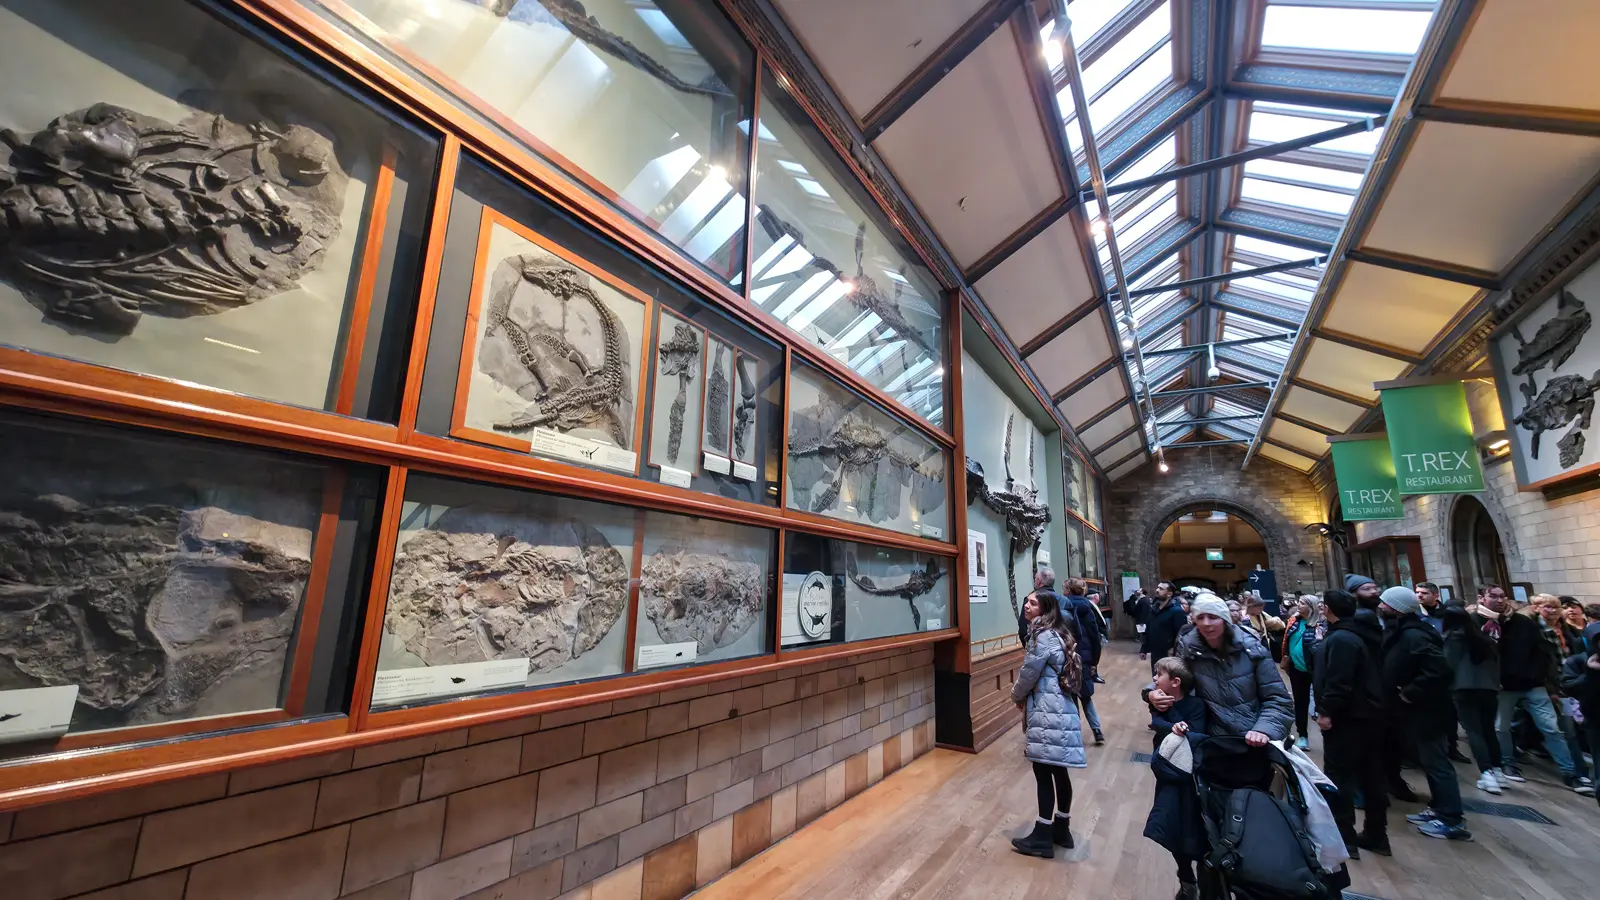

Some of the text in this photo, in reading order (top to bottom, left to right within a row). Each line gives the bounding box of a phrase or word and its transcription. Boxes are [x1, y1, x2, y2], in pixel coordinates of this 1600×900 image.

[1401, 451, 1471, 472] T.REX
[1405, 475, 1473, 487] RESTAURANT
[1344, 488, 1394, 504] T.REX
[1347, 506, 1395, 515] RESTAURANT
